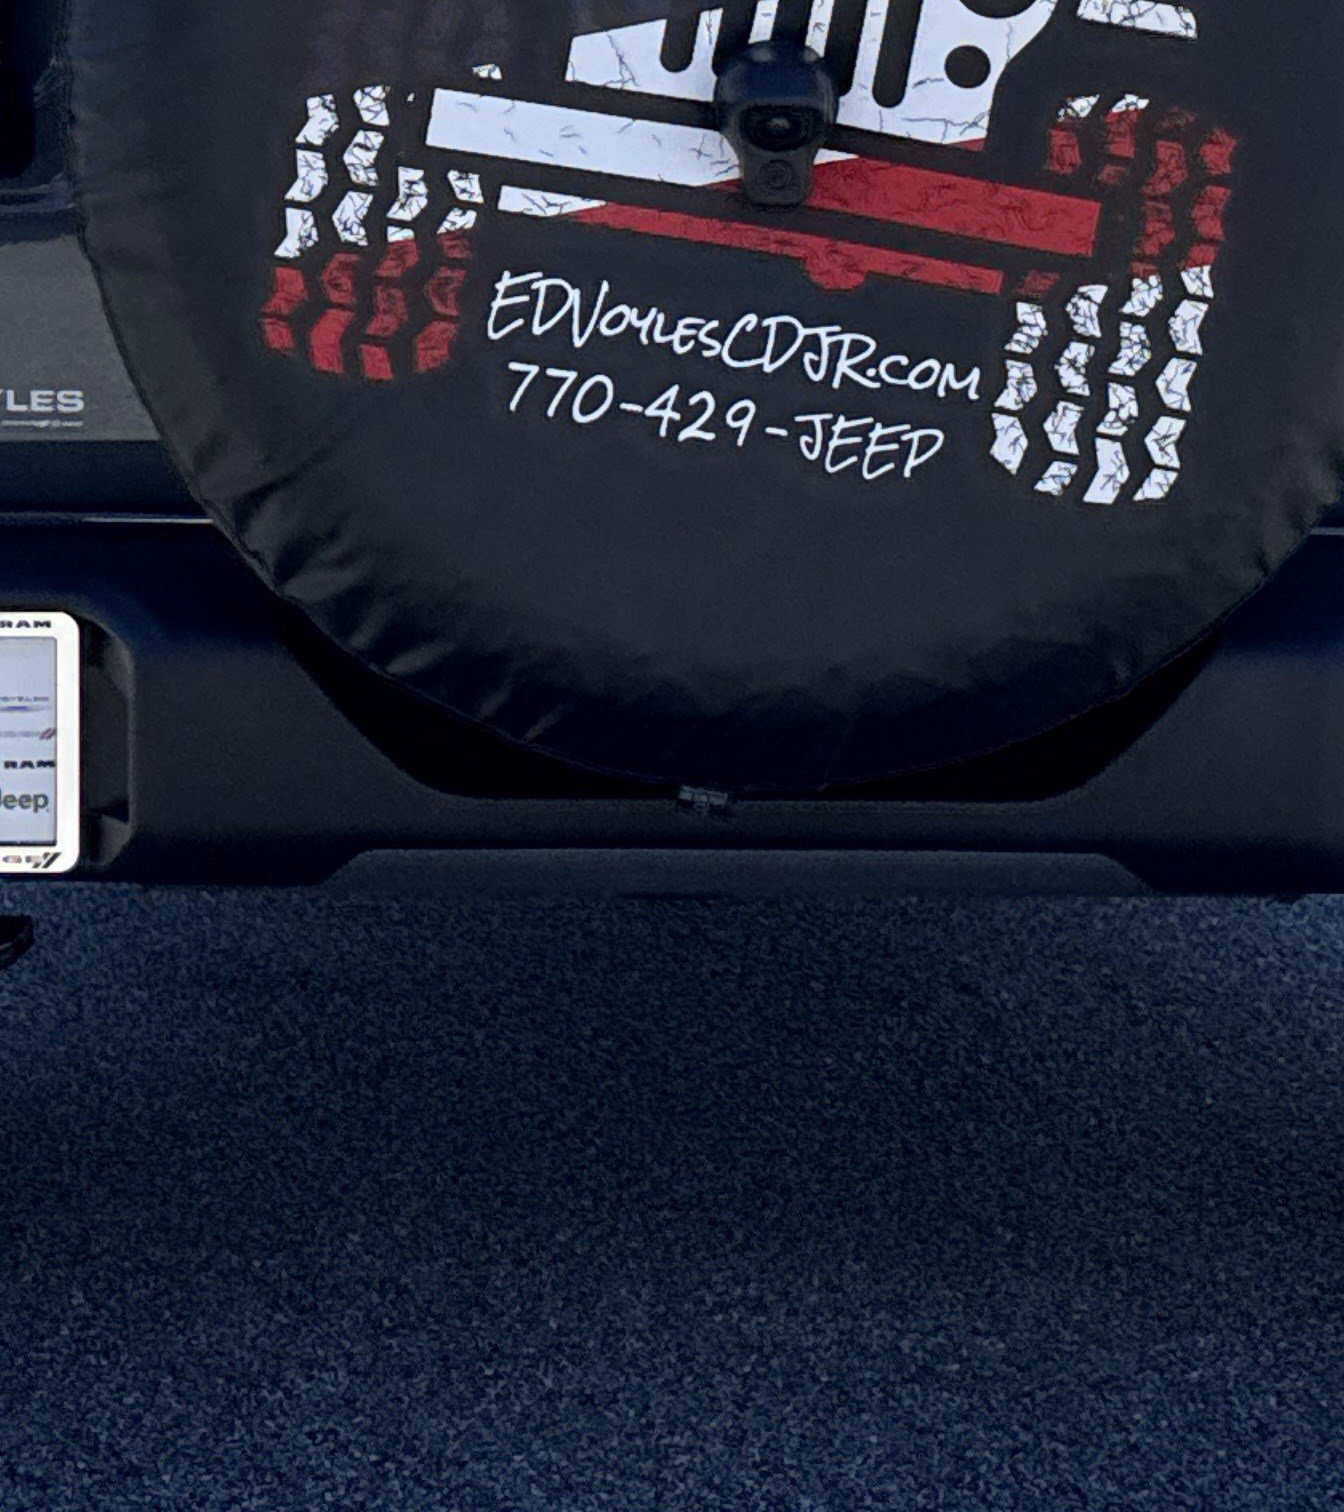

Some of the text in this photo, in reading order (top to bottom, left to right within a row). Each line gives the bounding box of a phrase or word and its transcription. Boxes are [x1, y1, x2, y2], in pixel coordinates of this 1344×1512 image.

[506, 362, 945, 480] 770-429-JEEP
[0, 619, 52, 629] RAM
[4, 759, 56, 770] RAM
